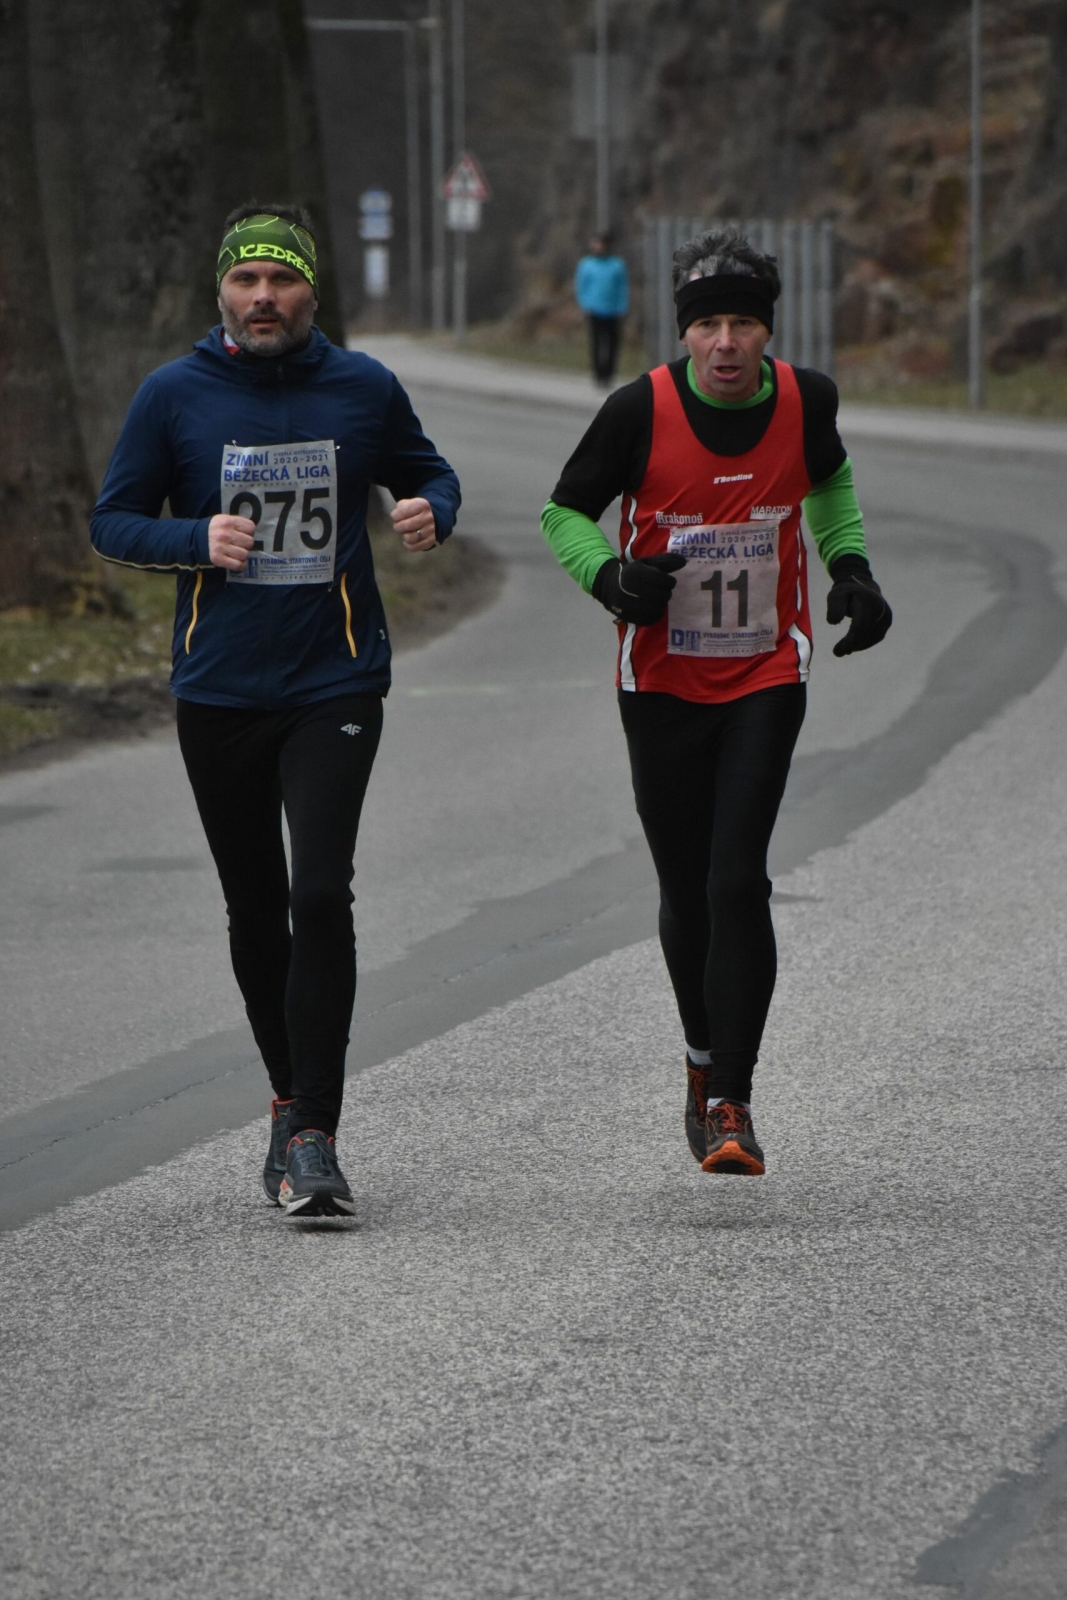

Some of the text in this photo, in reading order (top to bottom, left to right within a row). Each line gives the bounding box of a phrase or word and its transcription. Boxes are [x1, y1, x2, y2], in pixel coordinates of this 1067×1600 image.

[226, 451, 269, 466] ZIMNÍ
[224, 465, 330, 482] BĚŽECKÁ LIGA
[751, 505, 792, 515] MARATON
[229, 487, 333, 552] 275
[671, 530, 717, 546] ZIMNÍ
[743, 543, 774, 558] LIGA
[700, 569, 748, 628] 11
[340, 722, 362, 736] 4F
